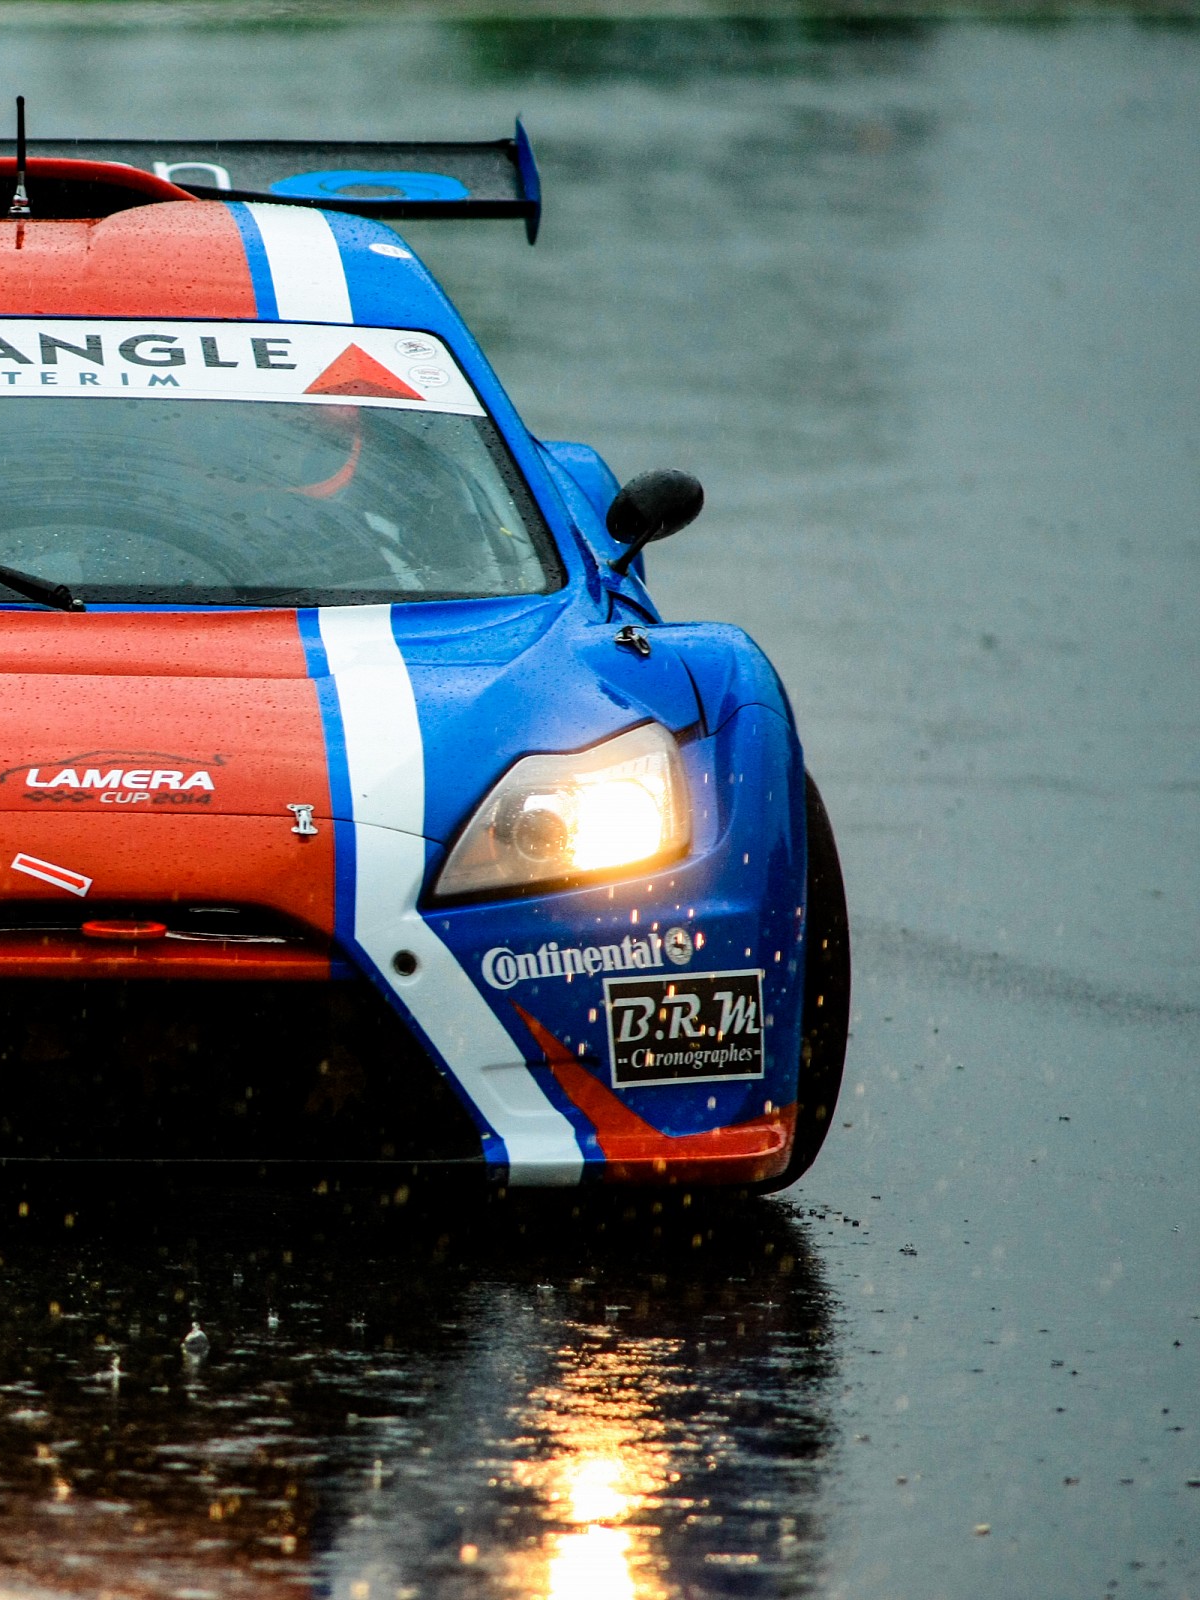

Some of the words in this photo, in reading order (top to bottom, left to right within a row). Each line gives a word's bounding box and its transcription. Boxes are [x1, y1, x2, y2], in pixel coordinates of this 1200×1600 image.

[25, 768, 215, 791] LAMERA
[99, 791, 151, 804] CUP
[153, 792, 212, 805] 2014
[481, 933, 664, 990] Continental
[610, 991, 763, 1043] B.R.M
